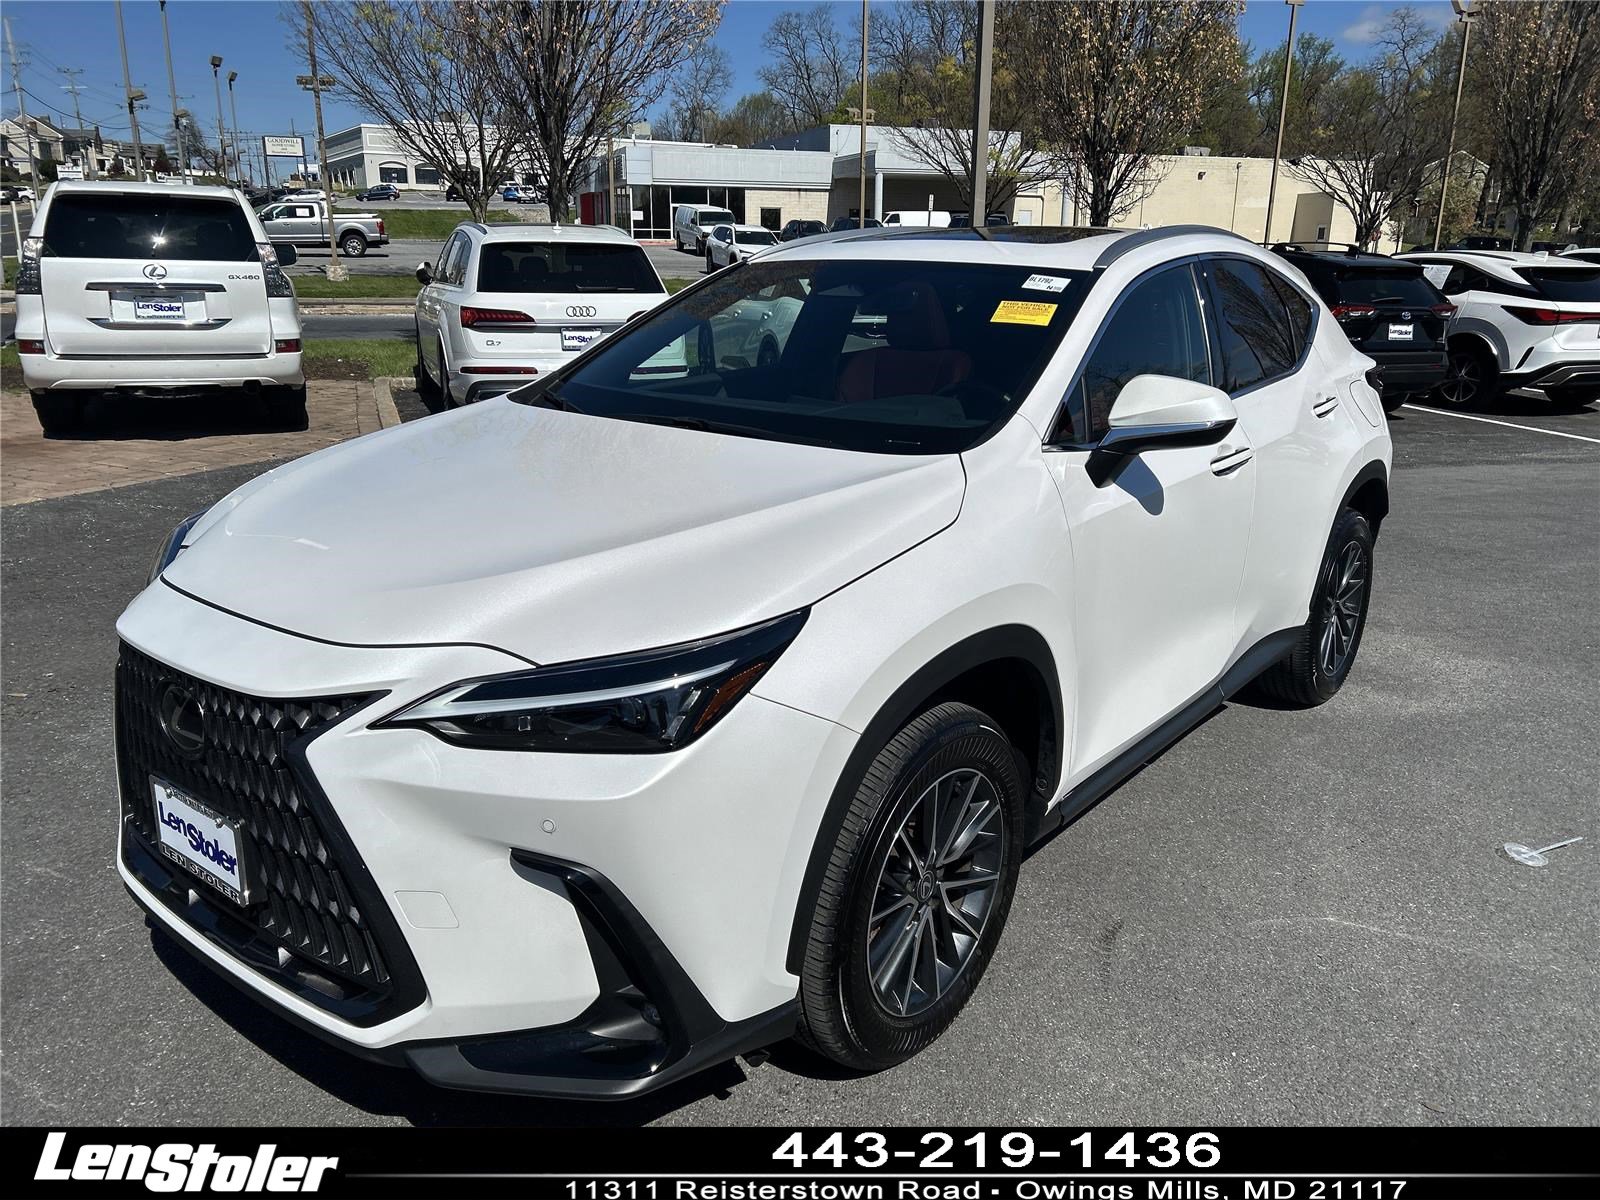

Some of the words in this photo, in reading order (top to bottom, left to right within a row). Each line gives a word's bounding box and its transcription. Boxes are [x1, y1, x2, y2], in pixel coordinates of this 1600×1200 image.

[267, 137, 300, 145] GOODWILL
[564, 334, 593, 343] LenStol
[162, 845, 187, 868] LEN
[190, 864, 241, 904] STOLER
